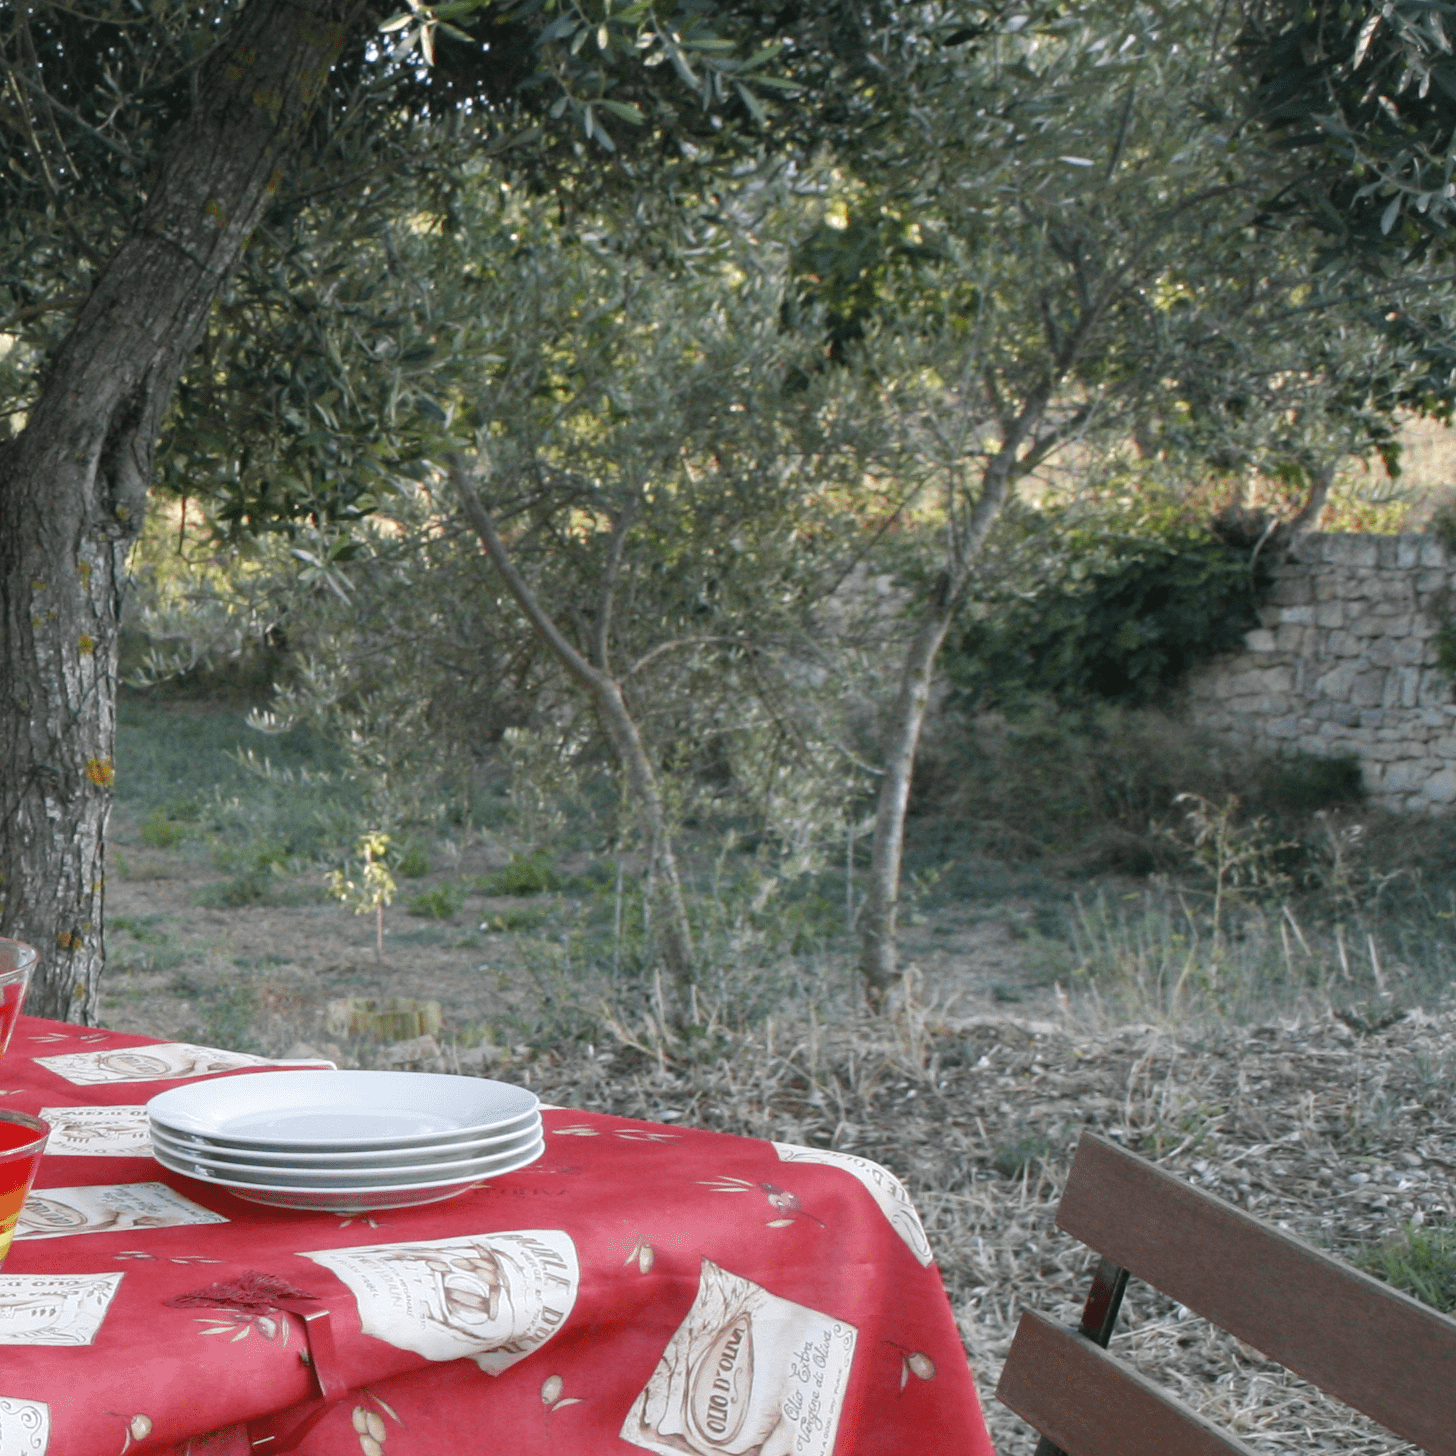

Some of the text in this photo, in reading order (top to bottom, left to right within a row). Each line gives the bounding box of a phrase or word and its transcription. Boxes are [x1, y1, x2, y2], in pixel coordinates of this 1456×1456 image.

[706, 1395, 729, 1434] OLIO
[783, 1341, 814, 1422] Olio Extra
[796, 1330, 833, 1452] Vergine di Oliva
